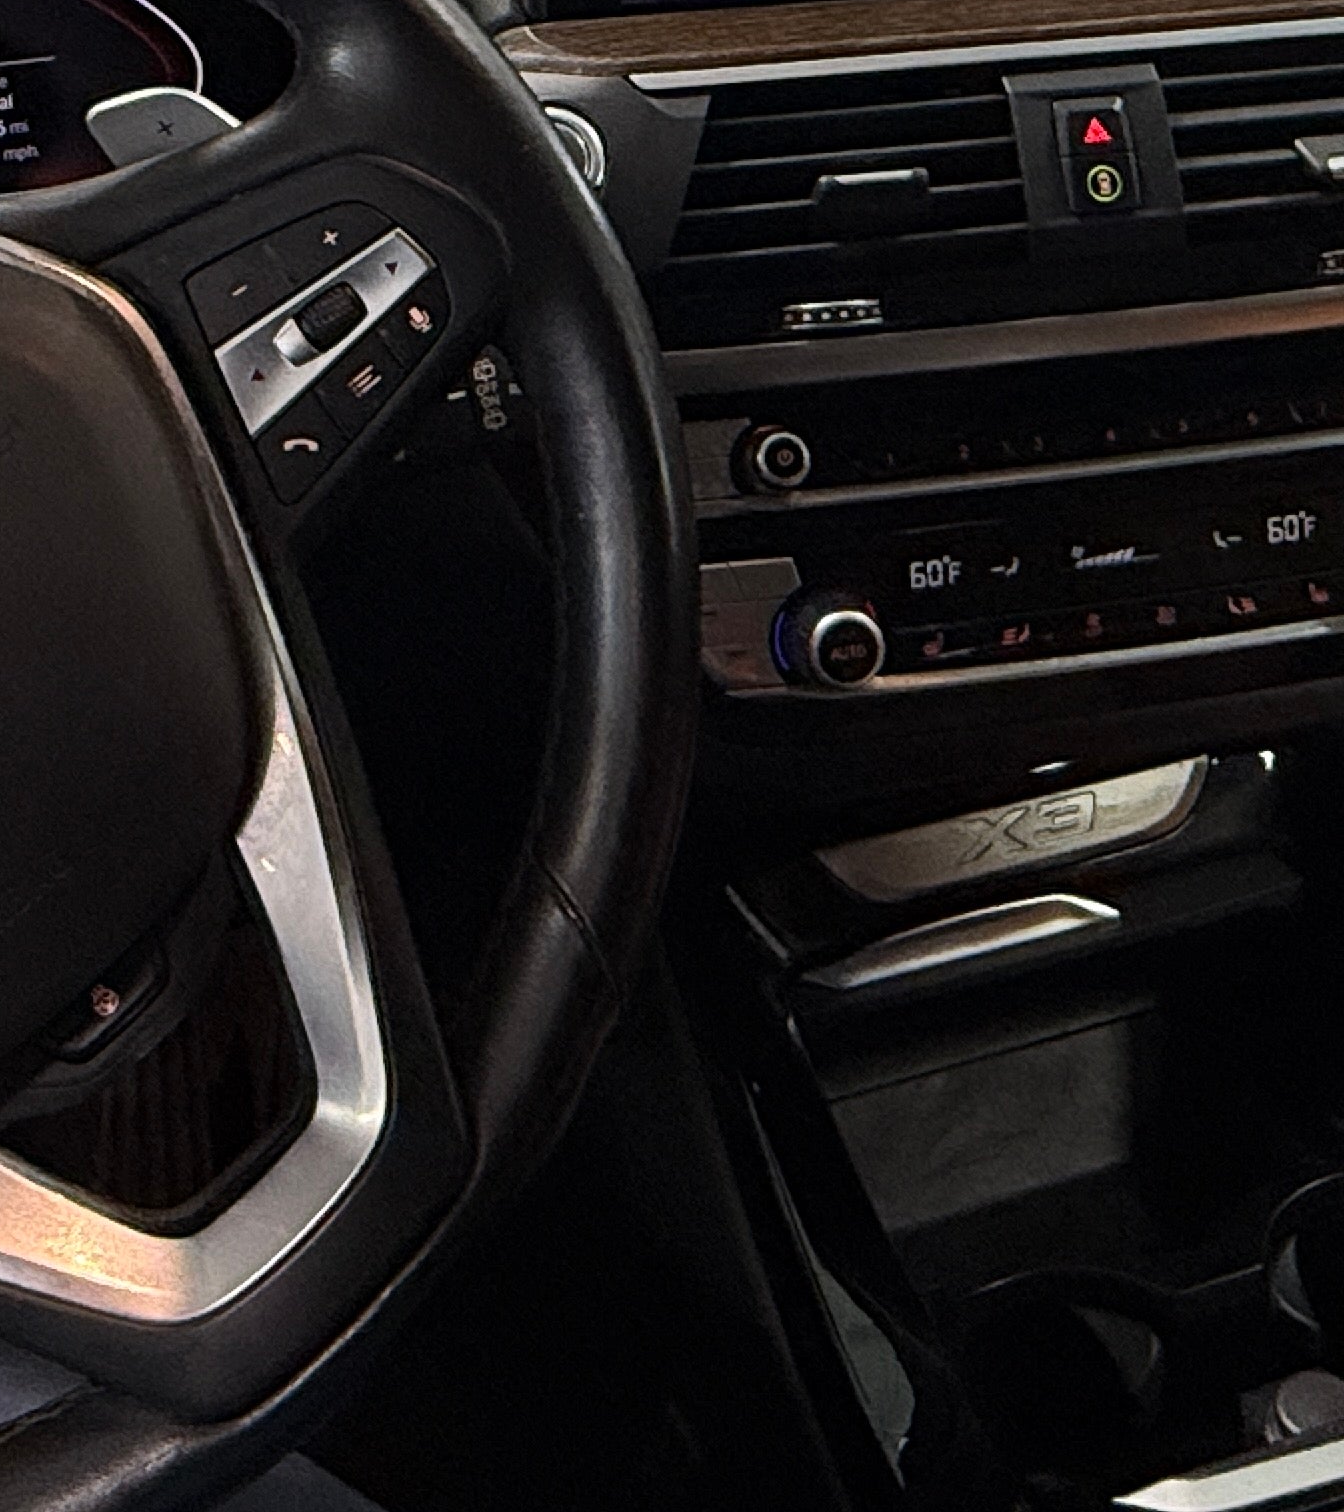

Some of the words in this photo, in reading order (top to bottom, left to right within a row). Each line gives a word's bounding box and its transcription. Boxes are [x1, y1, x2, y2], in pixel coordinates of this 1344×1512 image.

[9, 119, 30, 134] mi
[3, 144, 40, 162] mph
[959, 790, 1096, 866] X3
